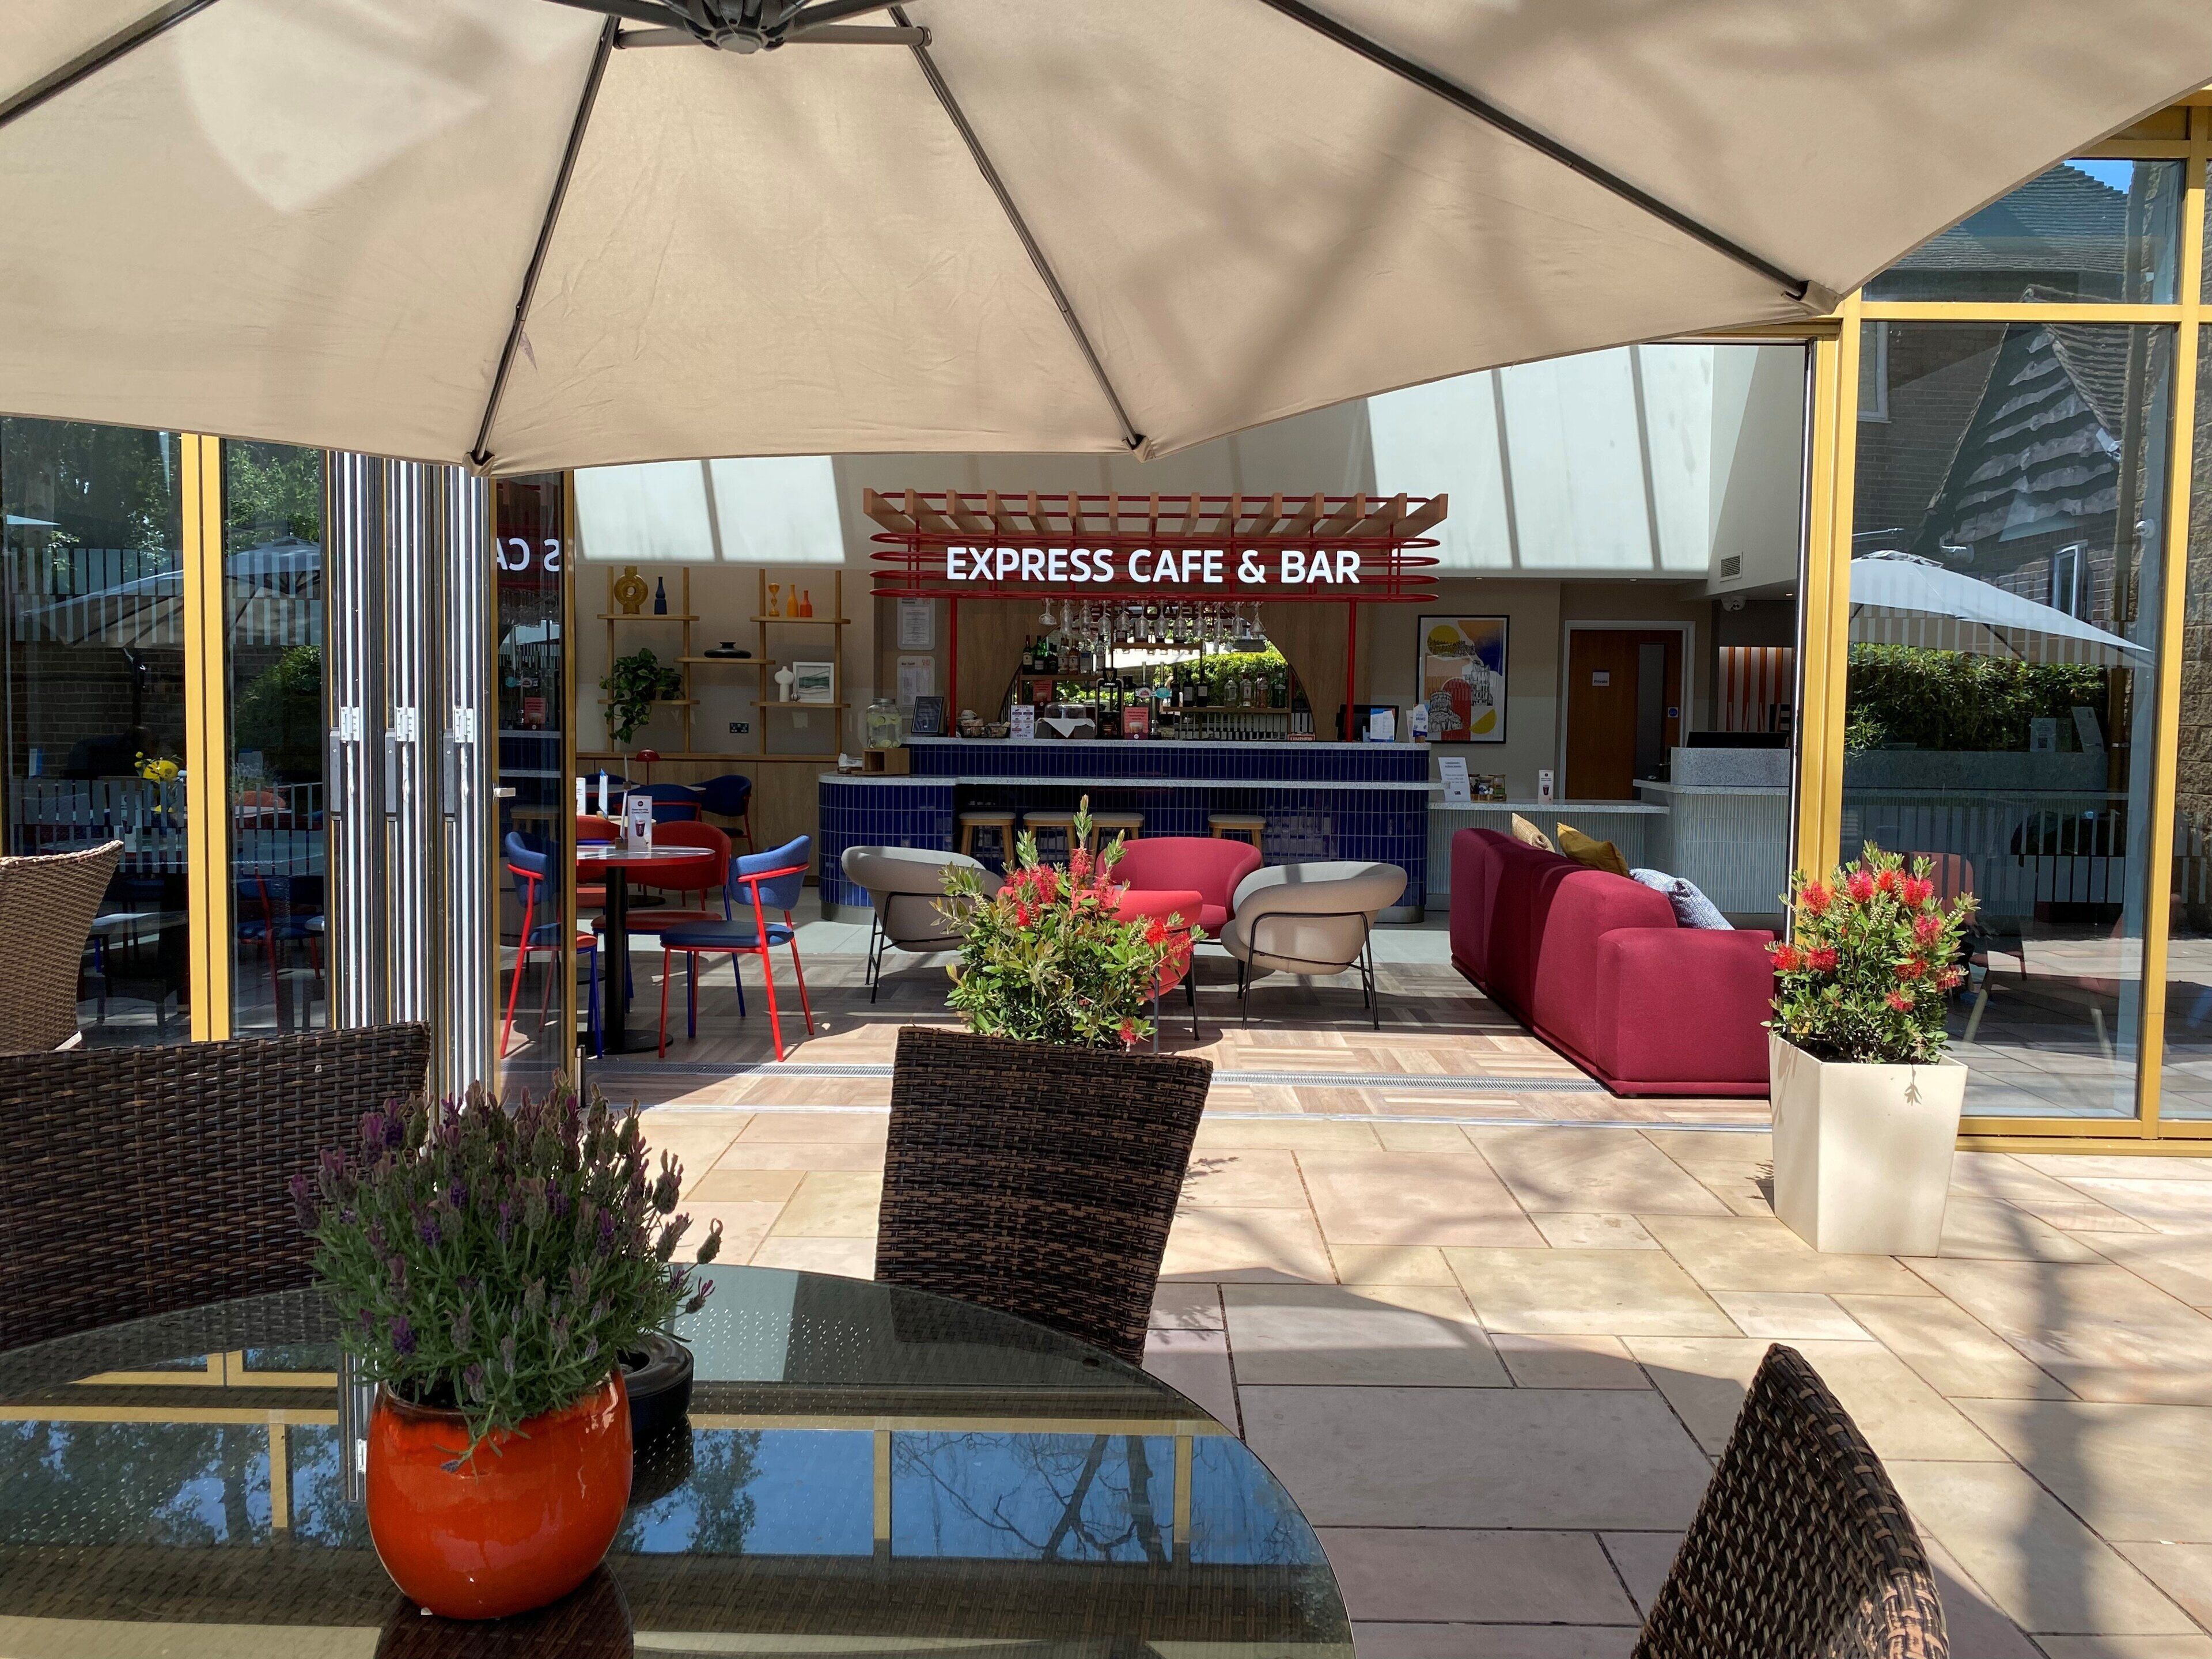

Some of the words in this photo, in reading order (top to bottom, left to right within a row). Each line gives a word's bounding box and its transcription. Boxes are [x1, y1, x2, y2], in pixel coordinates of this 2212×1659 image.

[946, 546, 1115, 582] EXPRESS
[1128, 548, 1224, 583] CAFE
[1237, 549, 1267, 584] &
[1281, 550, 1361, 584] BAR
